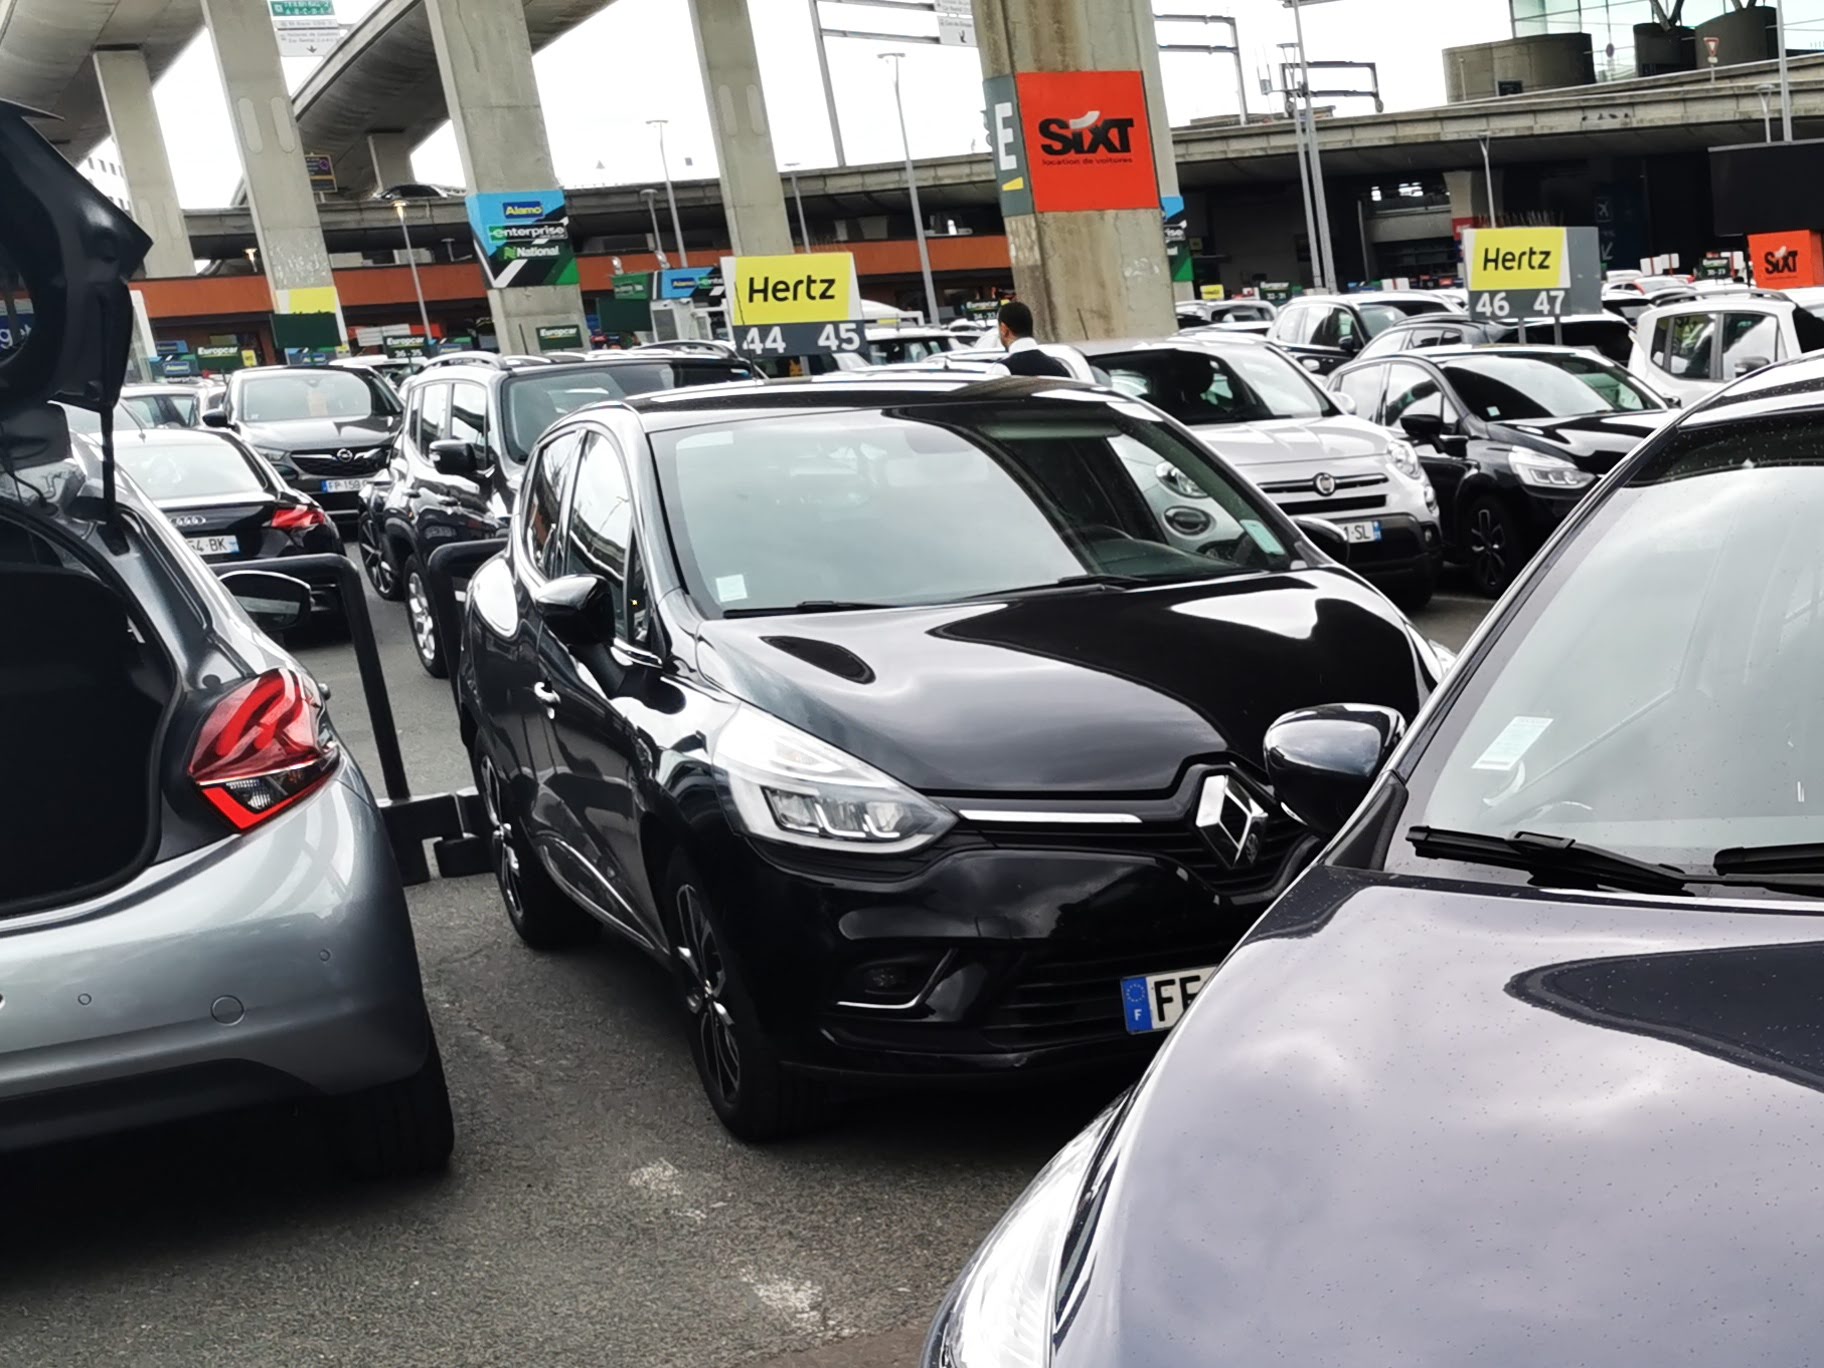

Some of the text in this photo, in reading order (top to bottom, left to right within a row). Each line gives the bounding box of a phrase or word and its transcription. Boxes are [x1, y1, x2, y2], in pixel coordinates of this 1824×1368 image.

[994, 101, 1018, 171] E
[1042, 158, 1081, 166] location
[505, 205, 543, 216] Alamo
[489, 225, 565, 239] enterprise
[516, 245, 561, 258] National
[1482, 246, 1552, 272] Hertz
[747, 274, 837, 304] Hertz
[1475, 290, 1566, 317] 46 47
[741, 322, 861, 355] 44 45
[197, 346, 239, 356] Europcar
[1134, 1008, 1142, 1021] F
